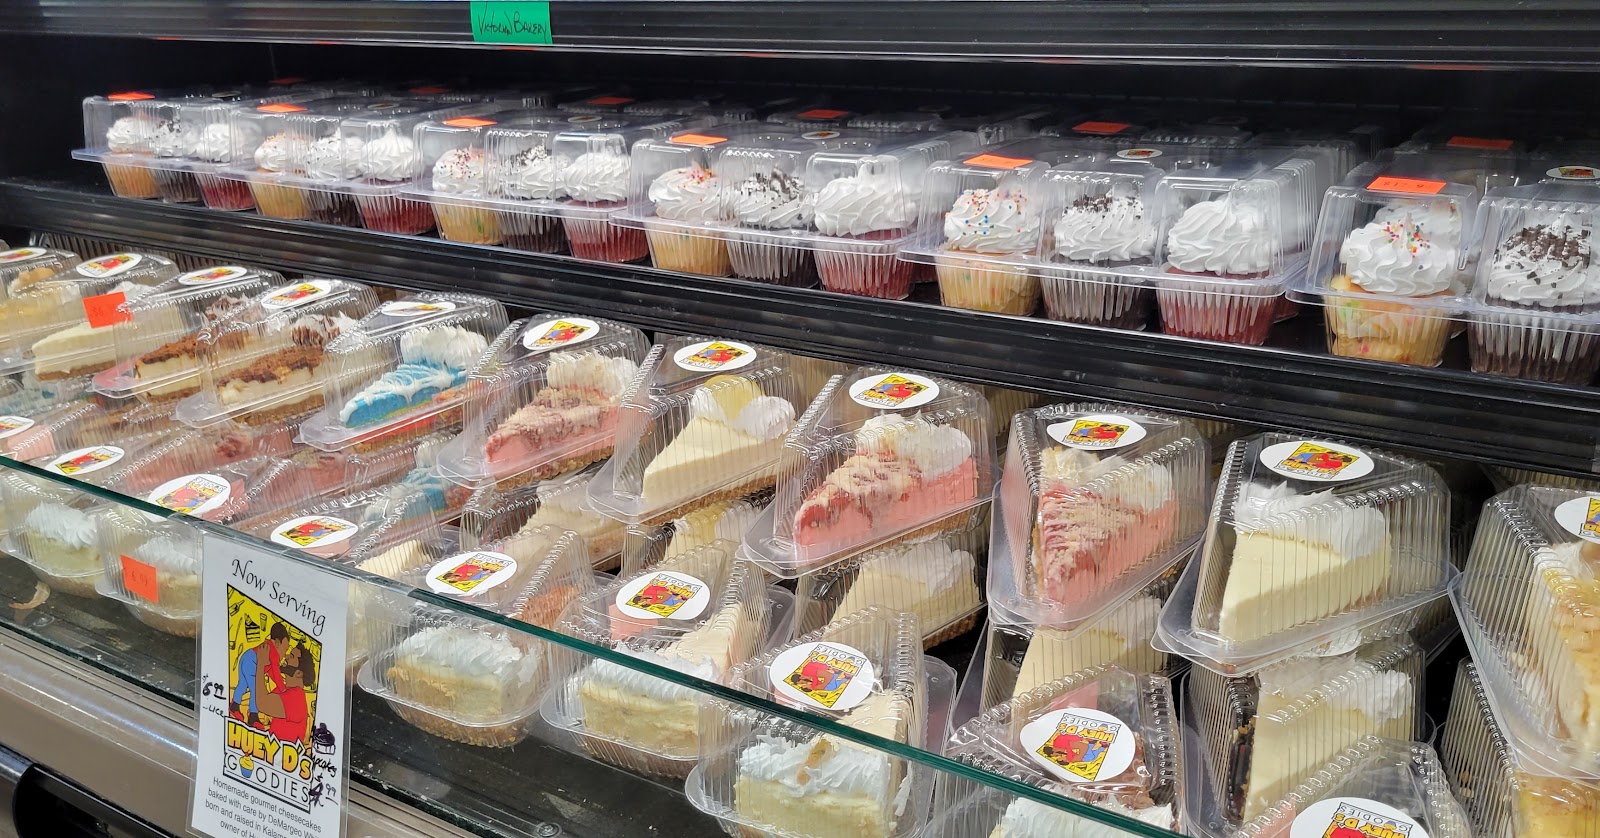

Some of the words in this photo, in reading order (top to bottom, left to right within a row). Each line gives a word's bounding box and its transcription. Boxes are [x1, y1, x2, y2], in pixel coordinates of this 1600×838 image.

[231, 558, 266, 591] Now
[269, 580, 327, 637] Serving
[827, 658, 857, 675] HUEY
[227, 720, 281, 766] HUEY
[1077, 729, 1114, 743] HUEY
[205, 799, 220, 812] born
[220, 807, 233, 819] and
[234, 812, 254, 828] raised
[255, 821, 262, 831] in
[208, 787, 228, 802] baked
[228, 796, 242, 809] with
[242, 803, 256, 816] care
[258, 809, 267, 821] by
[268, 814, 302, 837] DeMargeo
[213, 776, 249, 800] Homemade
[250, 795, 277, 813] gourmet
[278, 807, 322, 833] cheesecakes
[220, 821, 240, 834] owner
[240, 829, 248, 838] of
